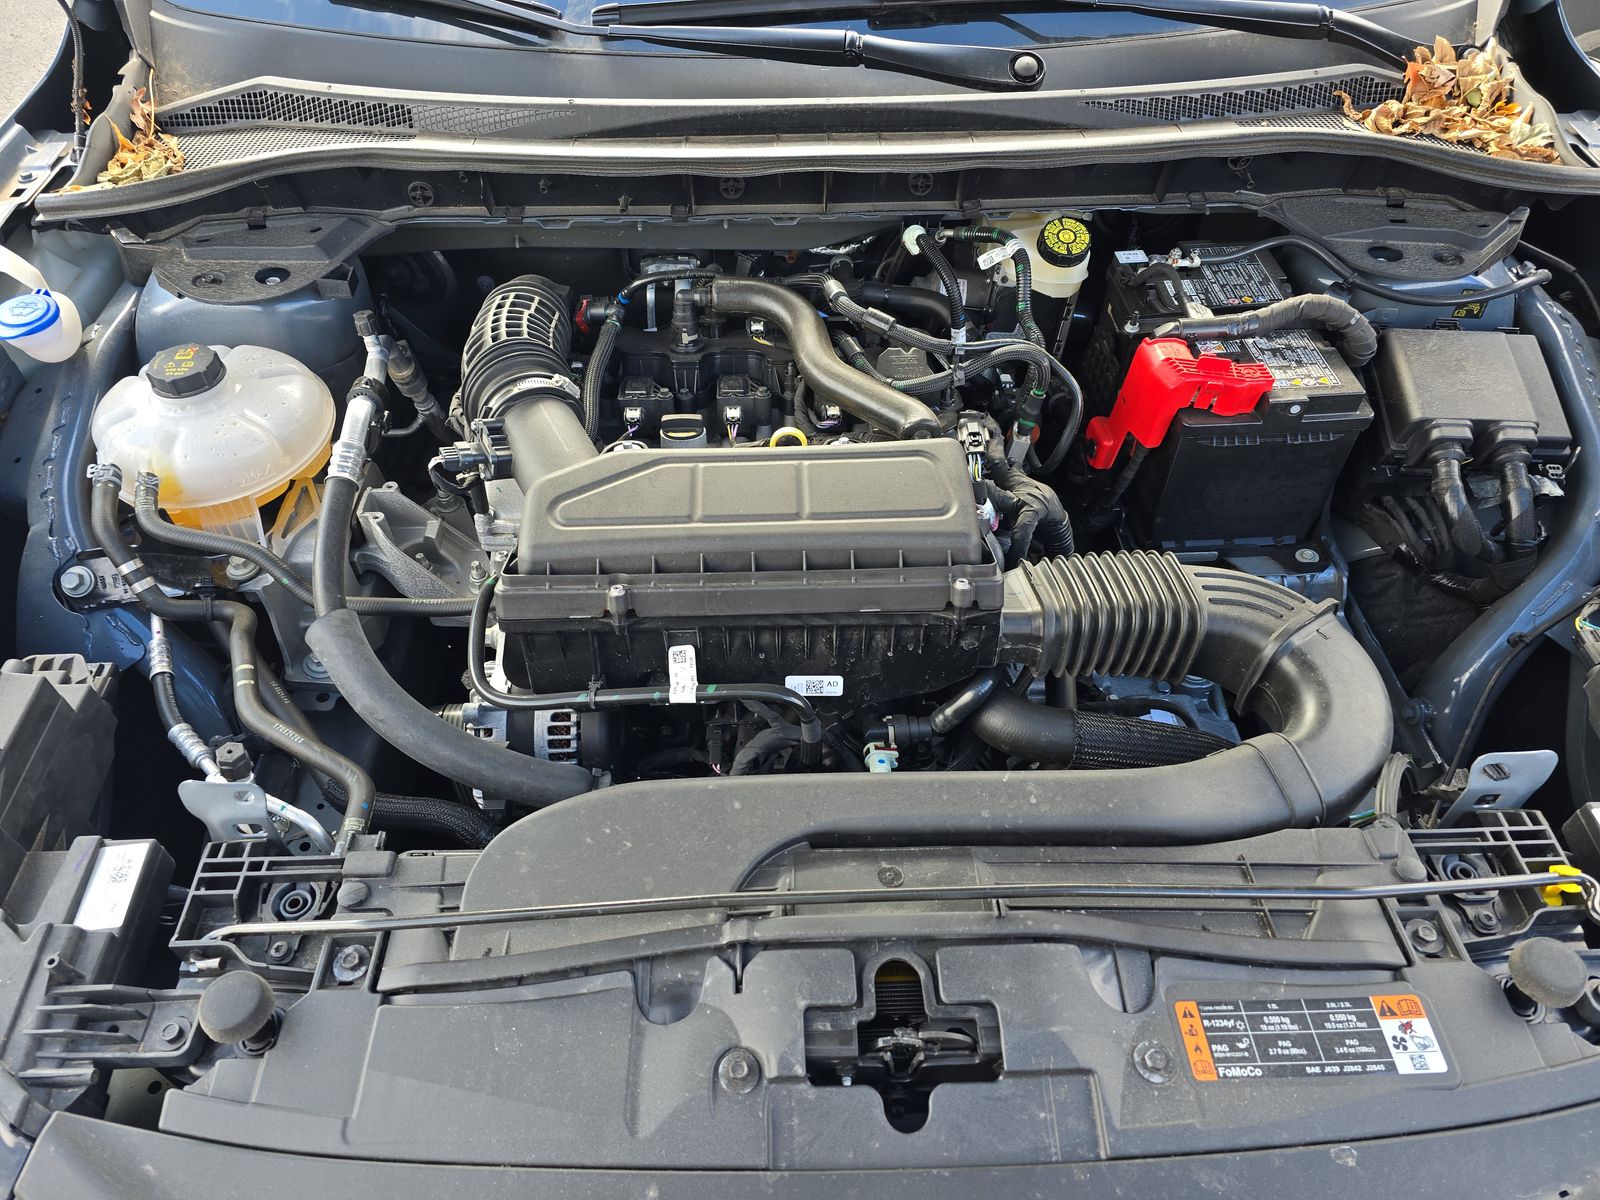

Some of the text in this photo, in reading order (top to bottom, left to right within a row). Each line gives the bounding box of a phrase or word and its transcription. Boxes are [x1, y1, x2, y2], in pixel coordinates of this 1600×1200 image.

[1280, 1016, 1290, 1024] kg
[1347, 1013, 1356, 1022] kg
[1203, 1019, 1234, 1028] R-1234yf
[1218, 1066, 1263, 1077] FoMoCo
